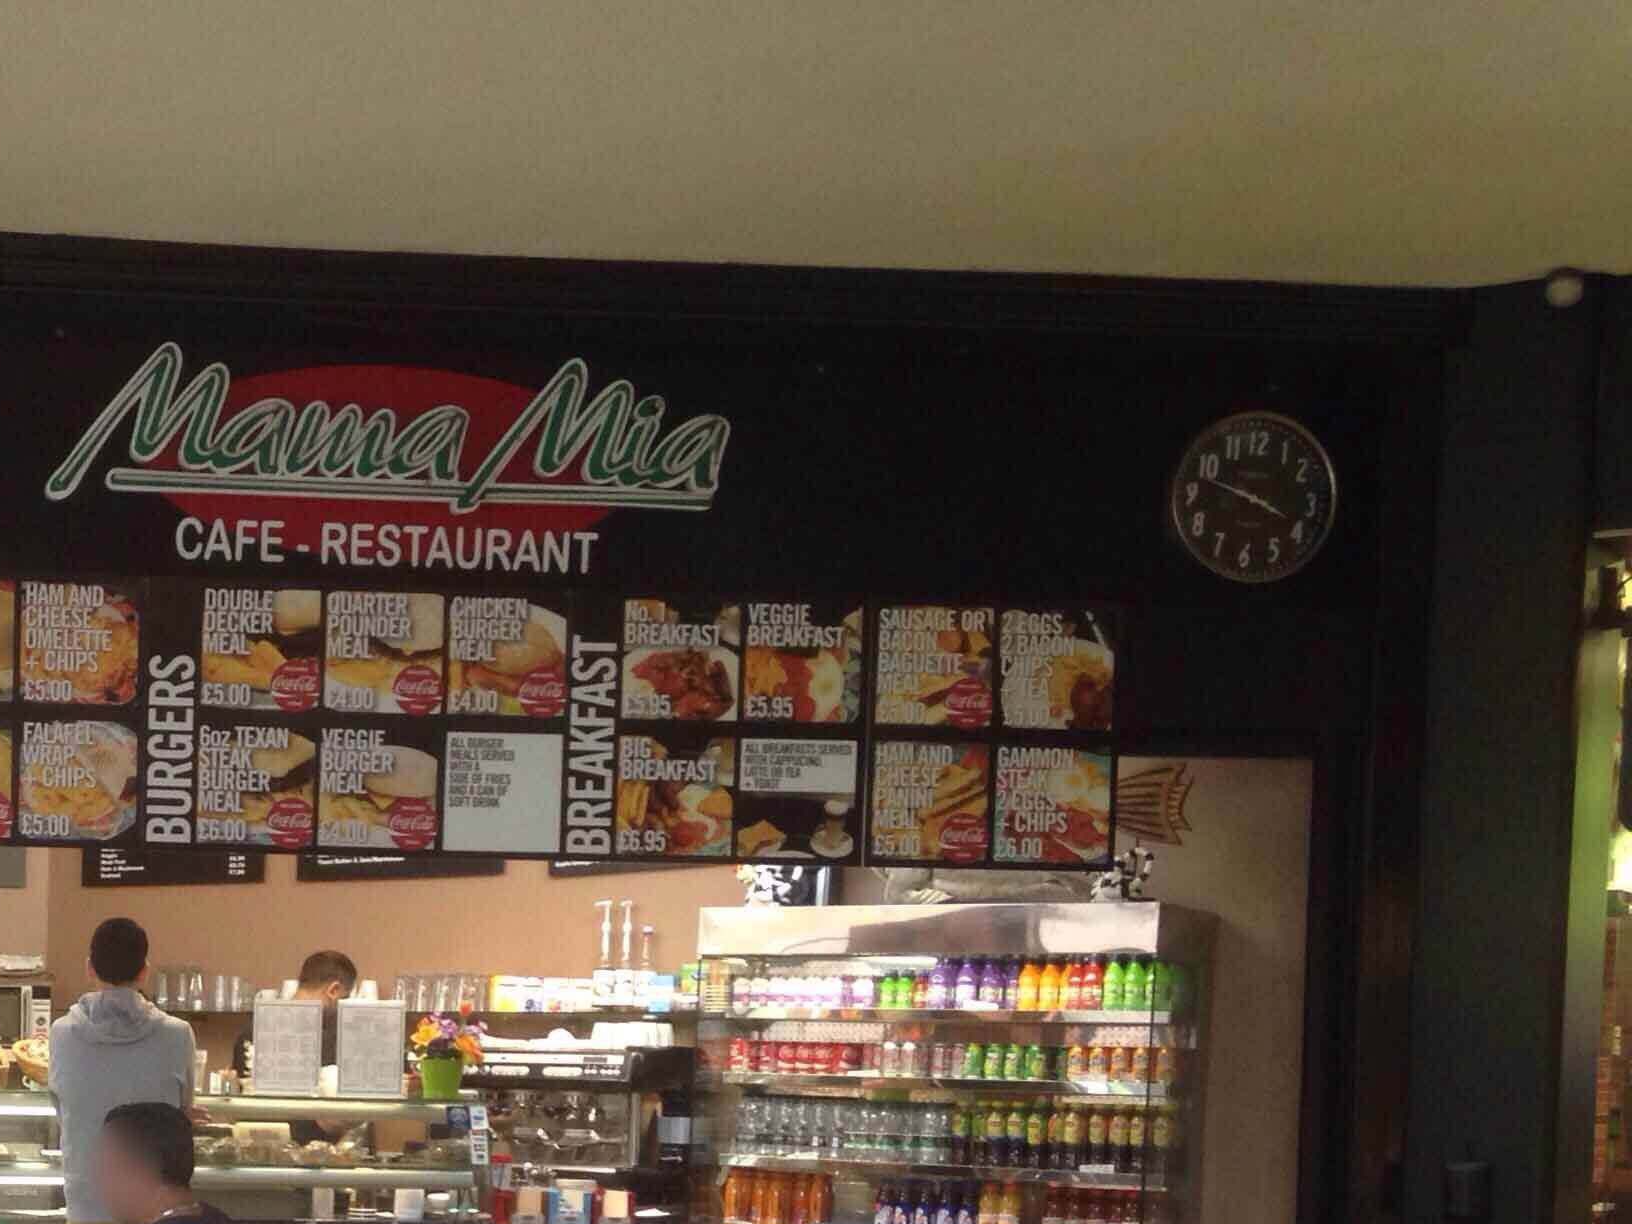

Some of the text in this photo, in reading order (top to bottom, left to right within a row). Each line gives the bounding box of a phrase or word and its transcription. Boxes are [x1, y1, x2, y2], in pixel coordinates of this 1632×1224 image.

[45, 342, 731, 511] Mama Mia
[1225, 435, 1241, 461] 11
[1249, 432, 1269, 456] 12
[1281, 441, 1288, 464] 1
[1199, 453, 1219, 479] 10
[1296, 458, 1308, 483] 2
[1185, 482, 1199, 505] 9
[1305, 493, 1316, 517] 3
[1192, 512, 1205, 536] 8
[1290, 520, 1303, 544] 4
[175, 516, 599, 575] CAFE RESTAURANT
[1215, 532, 1225, 557] 7
[1238, 543, 1251, 568] 6
[1268, 537, 1280, 562] 5
[25, 583, 104, 607] HAM AND
[204, 588, 273, 611] DOUBLE
[326, 592, 408, 615] QUARTER
[25, 607, 92, 628] CHEESE
[451, 596, 528, 619] CHICKEN
[748, 603, 811, 626] VEGGIE
[202, 611, 273, 633] DECKER
[326, 615, 411, 638] POUNDER
[451, 618, 523, 640] BURGER
[880, 609, 984, 632] SAUSAGE OR
[1002, 611, 1063, 634] 2 EGGS
[25, 629, 113, 651] OMELETTE
[202, 633, 251, 655] MEAL
[625, 623, 720, 646] BREAKFAST
[747, 625, 845, 648] BREAKFAST
[879, 631, 937, 651] BACON
[1002, 635, 1074, 656] 2 BACON
[326, 636, 374, 658] MEAL
[449, 640, 497, 662] MEAL
[26, 650, 98, 672] + CHIPS
[878, 652, 962, 673] BAGUETTE
[1001, 656, 1053, 677] CHIPS
[23, 679, 72, 701] £5.00
[201, 683, 251, 705] £5.00
[624, 695, 671, 717] £5.95
[745, 696, 794, 718] £5.95
[23, 721, 94, 745] FALAFEL
[198, 726, 289, 749] 6oz TEXAN
[321, 728, 386, 750] VEGGIE
[567, 634, 618, 854] BREAKFAST
[22, 743, 74, 764] WRAP
[146, 653, 195, 843] BURGERS
[623, 737, 652, 757] BIG
[875, 742, 953, 764] HAM AND
[197, 749, 252, 769] STEAK
[320, 750, 394, 773] BURGER
[623, 759, 718, 782] BREAKFAST
[42, 767, 97, 788] CHIPS
[197, 769, 270, 791] BURGER
[320, 773, 369, 794] MEAL
[874, 766, 941, 786] CHEESE
[996, 770, 1048, 790] STEAK
[197, 791, 244, 813] MEAL
[874, 788, 934, 808] PANINI
[1013, 791, 1056, 811] EGGS
[21, 814, 70, 837] £5.00
[197, 818, 247, 841] £6.00
[874, 809, 920, 828] MEAL
[1014, 811, 1068, 833] CHIPS
[618, 830, 666, 853] £6.95
